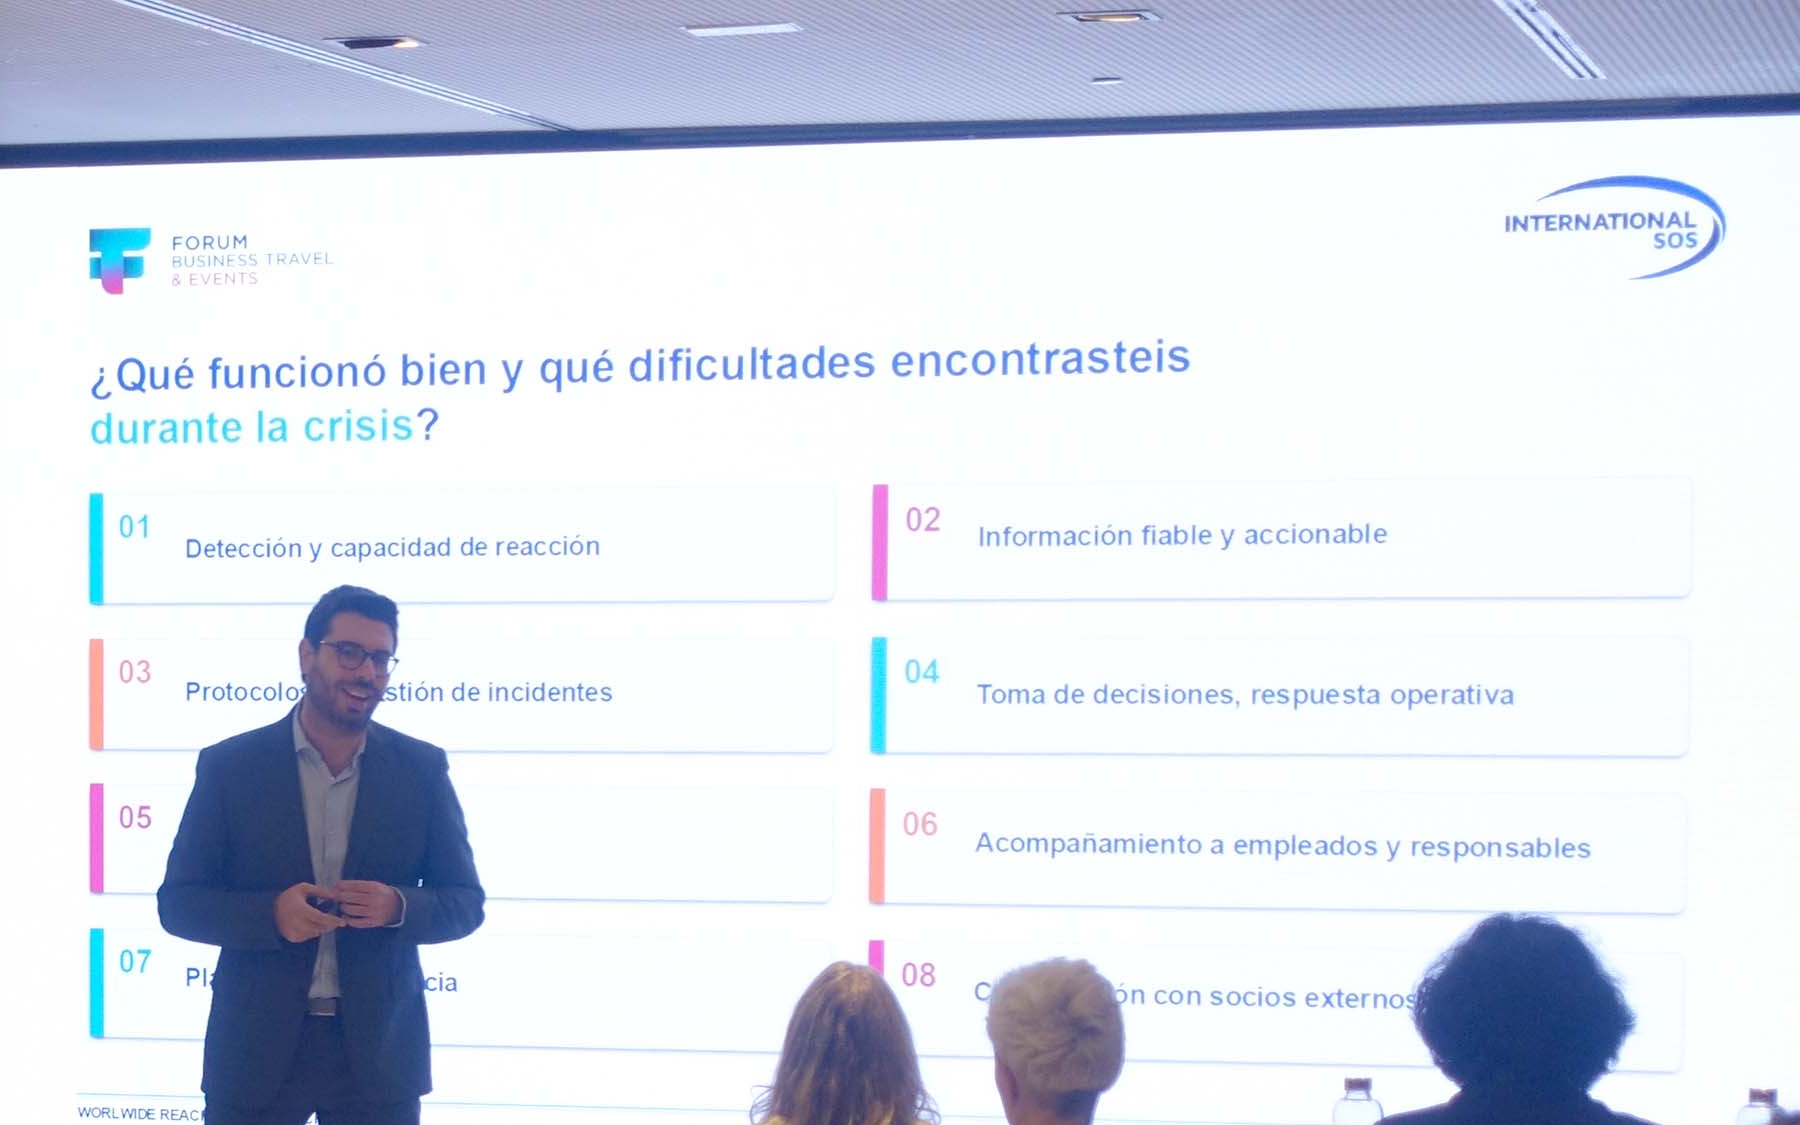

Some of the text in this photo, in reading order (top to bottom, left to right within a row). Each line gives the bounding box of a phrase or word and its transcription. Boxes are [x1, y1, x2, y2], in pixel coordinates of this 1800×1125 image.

[1504, 211, 1698, 233] INTERNATIONAL
[171, 234, 249, 251] FORUM
[1653, 232, 1699, 251] SOS
[171, 251, 334, 269] BUSINESS TRAVEL
[171, 271, 260, 287] & EVENTS
[90, 339, 1191, 401] ¿Qué funcionó bien y qué dificultades encontrasteis
[89, 407, 440, 446] durante la crisis?
[119, 513, 150, 540] 01
[906, 506, 941, 532] 02
[185, 533, 600, 564] Detección y capacidad de reacción
[979, 522, 1388, 551] Información fiable y accionable
[119, 659, 152, 684] 03
[904, 658, 941, 685] 04
[451, 681, 481, 703] de
[488, 680, 613, 703] incidentes
[976, 683, 1515, 711] Toma de decisiones, respuesta operativa
[119, 804, 153, 830] 05
[903, 811, 938, 836] 06
[975, 832, 1592, 864] Acompañamiento a empleados y responsables
[119, 948, 153, 974] 07
[901, 961, 937, 988] 08
[1154, 988, 1202, 1006] con
[1210, 986, 1297, 1008] socios
[77, 1106, 156, 1121] WORLWIDE
